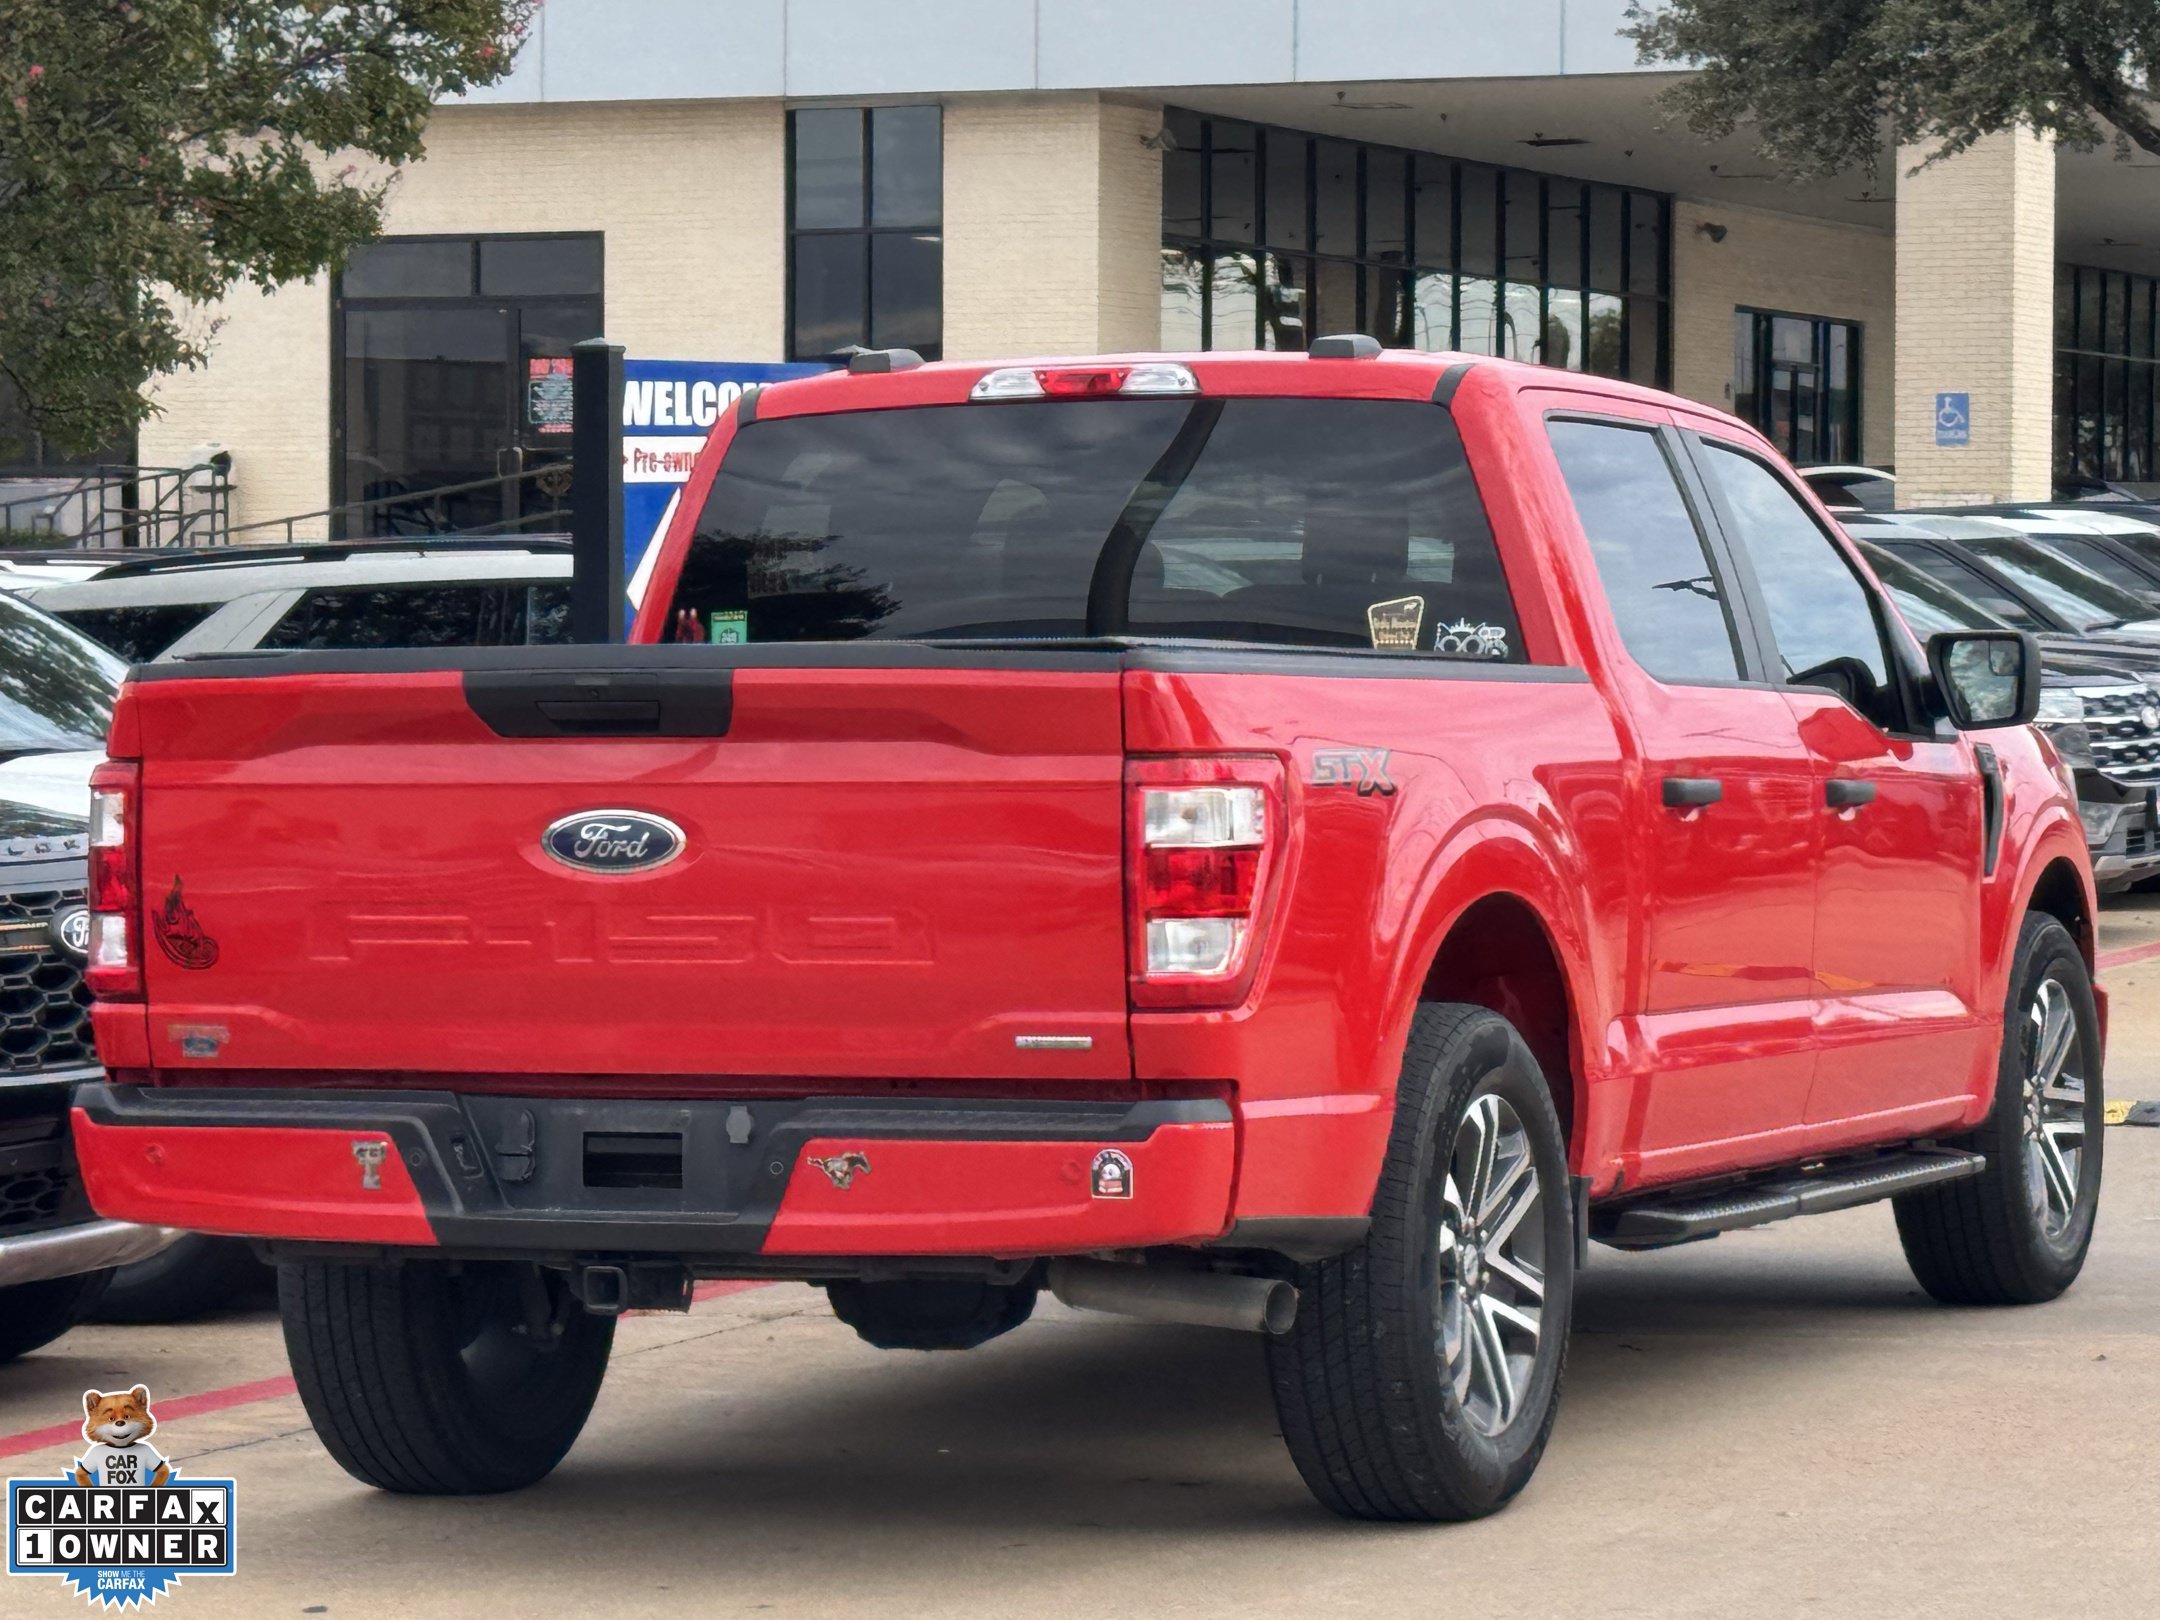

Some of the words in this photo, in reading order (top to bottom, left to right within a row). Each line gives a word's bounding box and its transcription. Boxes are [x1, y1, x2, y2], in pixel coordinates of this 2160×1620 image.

[622, 381, 773, 427] WELCO
[1312, 748, 1396, 795] STX
[573, 823, 650, 859] Ford
[306, 900, 936, 966] F-150
